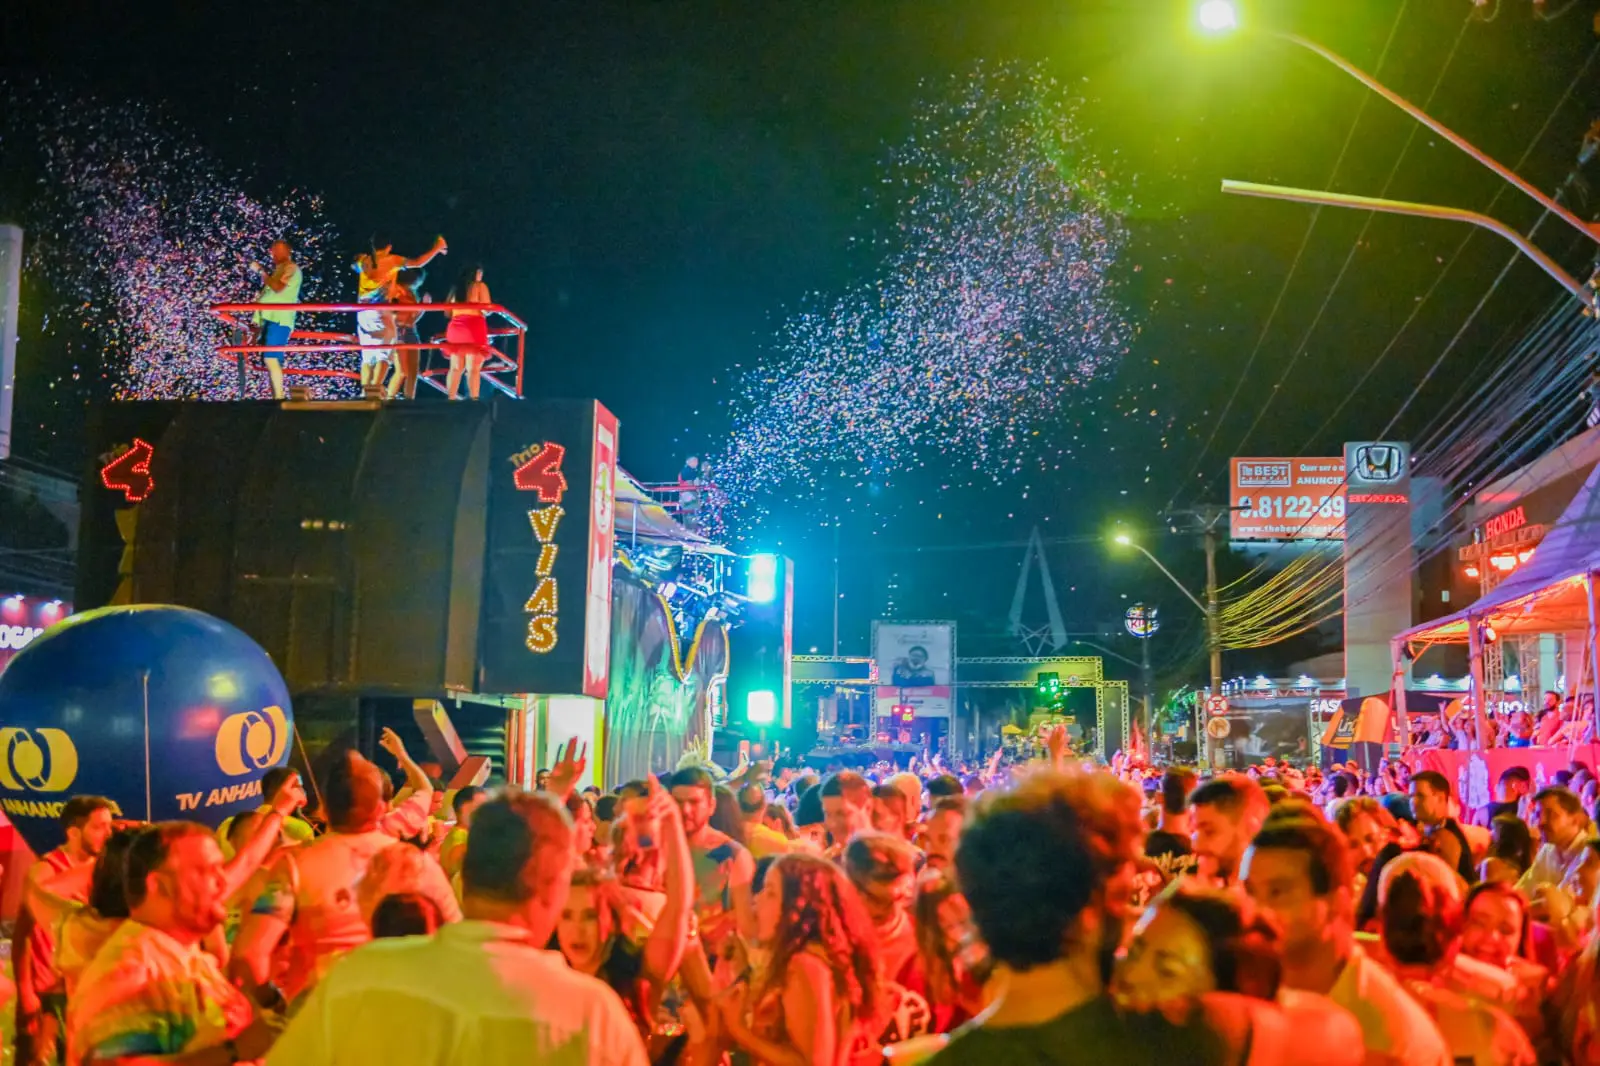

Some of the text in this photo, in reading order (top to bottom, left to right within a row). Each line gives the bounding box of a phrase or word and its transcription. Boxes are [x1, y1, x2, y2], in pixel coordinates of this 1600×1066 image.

[101, 437, 154, 502] 4
[513, 441, 568, 502] 4
[1254, 466, 1287, 475] BEST
[1296, 477, 1344, 485] ANUNCIE
[1348, 494, 1409, 504] HONDA
[1486, 506, 1527, 540] HONDA
[524, 504, 565, 653] VIAS
[176, 792, 203, 811] TV
